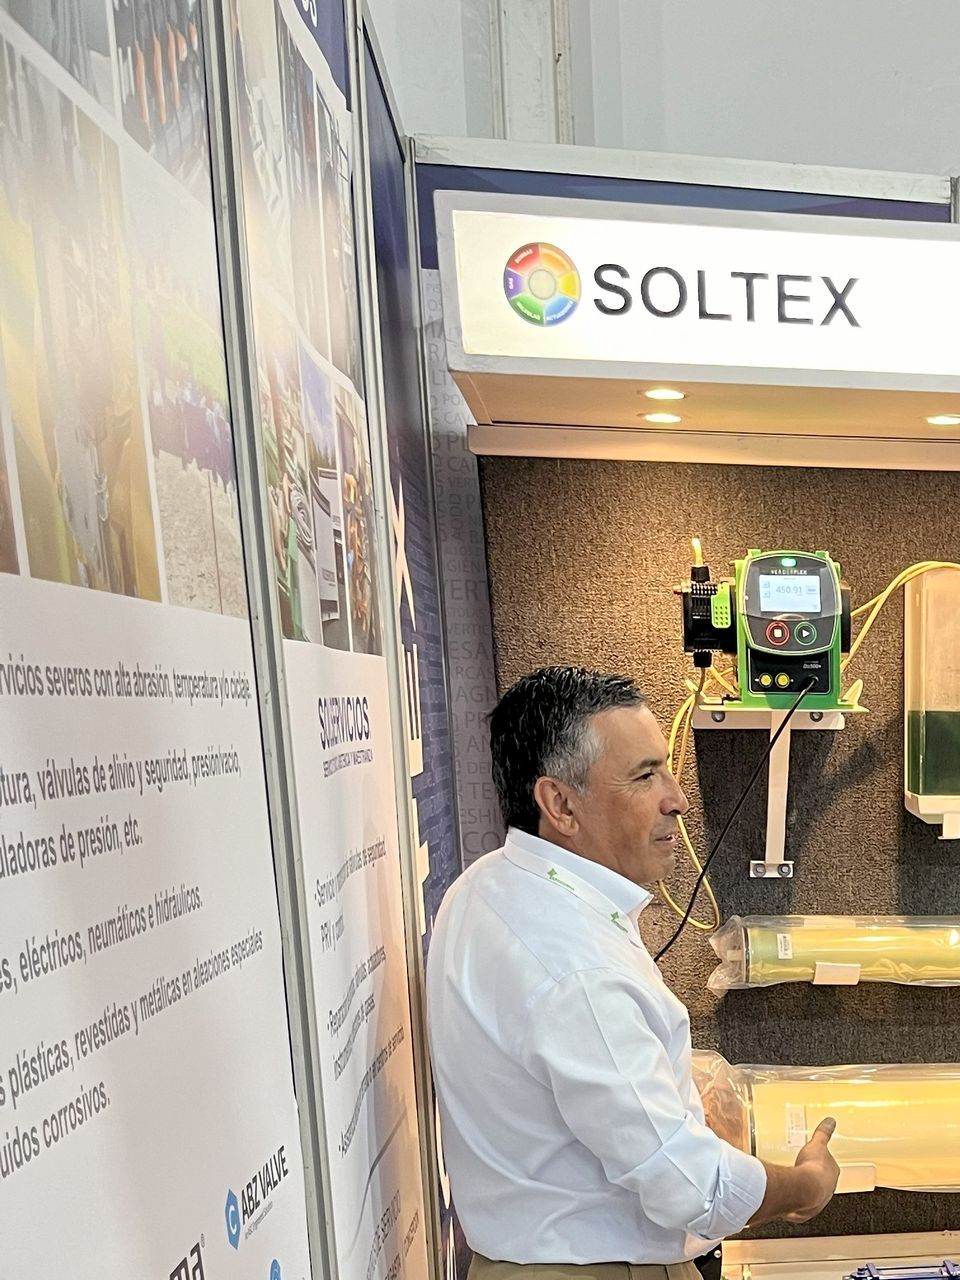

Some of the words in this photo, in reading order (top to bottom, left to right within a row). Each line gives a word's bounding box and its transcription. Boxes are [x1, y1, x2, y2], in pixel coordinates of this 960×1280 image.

[593, 263, 861, 328] SOLTEX
[46, 664, 92, 697] severos
[94, 667, 115, 698] con
[115, 661, 132, 698] alta
[173, 667, 219, 707] temperatura
[37, 758, 91, 801] válvulas
[93, 755, 107, 792] de
[108, 753, 136, 791] alivio
[137, 763, 144, 796] y
[145, 748, 192, 793] seguridad,
[59, 823, 76, 864] de
[77, 814, 124, 869] presión,
[124, 814, 144, 848] etc.
[19, 928, 88, 985] eléctricos,
[87, 904, 147, 956] neumáticos
[148, 903, 155, 930] e
[154, 883, 204, 927] hidráulicos.
[8, 1038, 76, 1110] plásticas,
[74, 1002, 132, 1061] revestidas
[130, 1000, 140, 1037] y
[139, 974, 182, 1023] metálicas
[182, 966, 194, 997] en
[193, 950, 232, 989] aleaciones
[42, 1081, 111, 1149] corrosivos.
[241, 1176, 261, 1226] ABZ
[258, 1145, 289, 1200] VALVE
